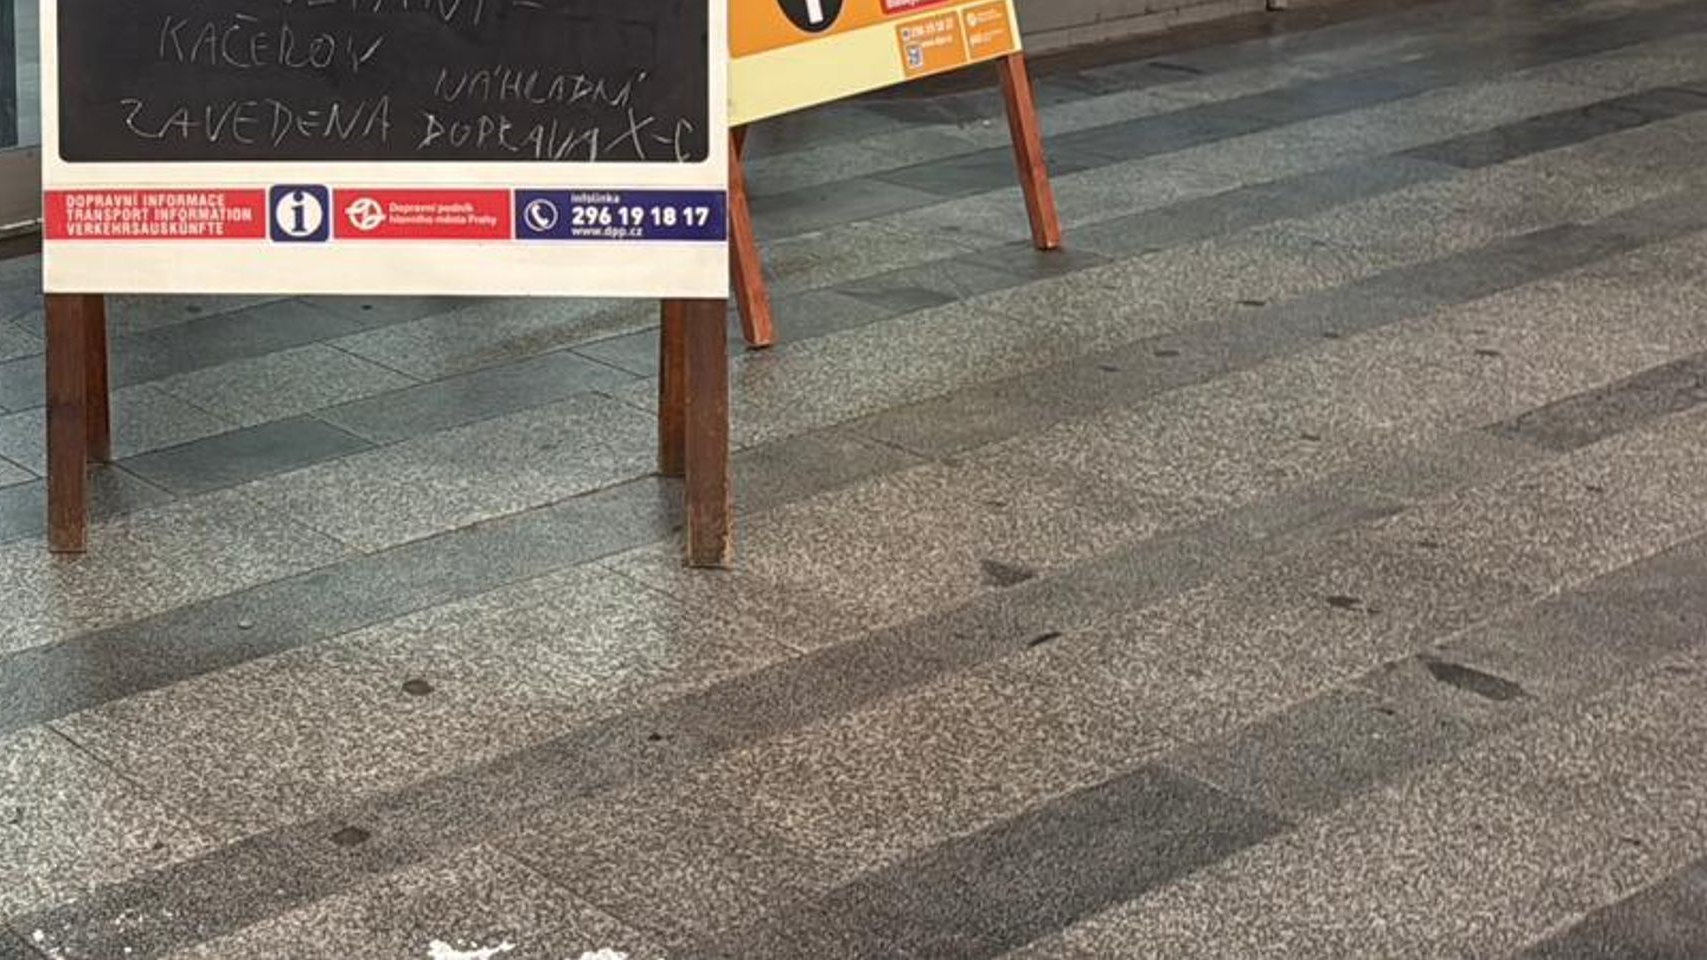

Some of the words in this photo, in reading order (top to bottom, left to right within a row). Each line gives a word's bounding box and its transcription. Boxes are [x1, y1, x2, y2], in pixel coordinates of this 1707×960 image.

[119, 95, 392, 148] ZAVEDENA
[66, 191, 138, 208] DOPRAVNÍ
[143, 193, 226, 208] INFORMACE
[570, 191, 621, 204] infolinka
[66, 207, 150, 222] TRANSPORT
[154, 207, 253, 222] INFORMATION
[571, 206, 613, 227] 296
[617, 206, 644, 227] 19
[650, 206, 677, 227] 18
[682, 206, 710, 227] 17
[66, 220, 225, 236] VERKEHRSAUSKÜNFTE
[571, 225, 644, 239] www.dpp.cz
